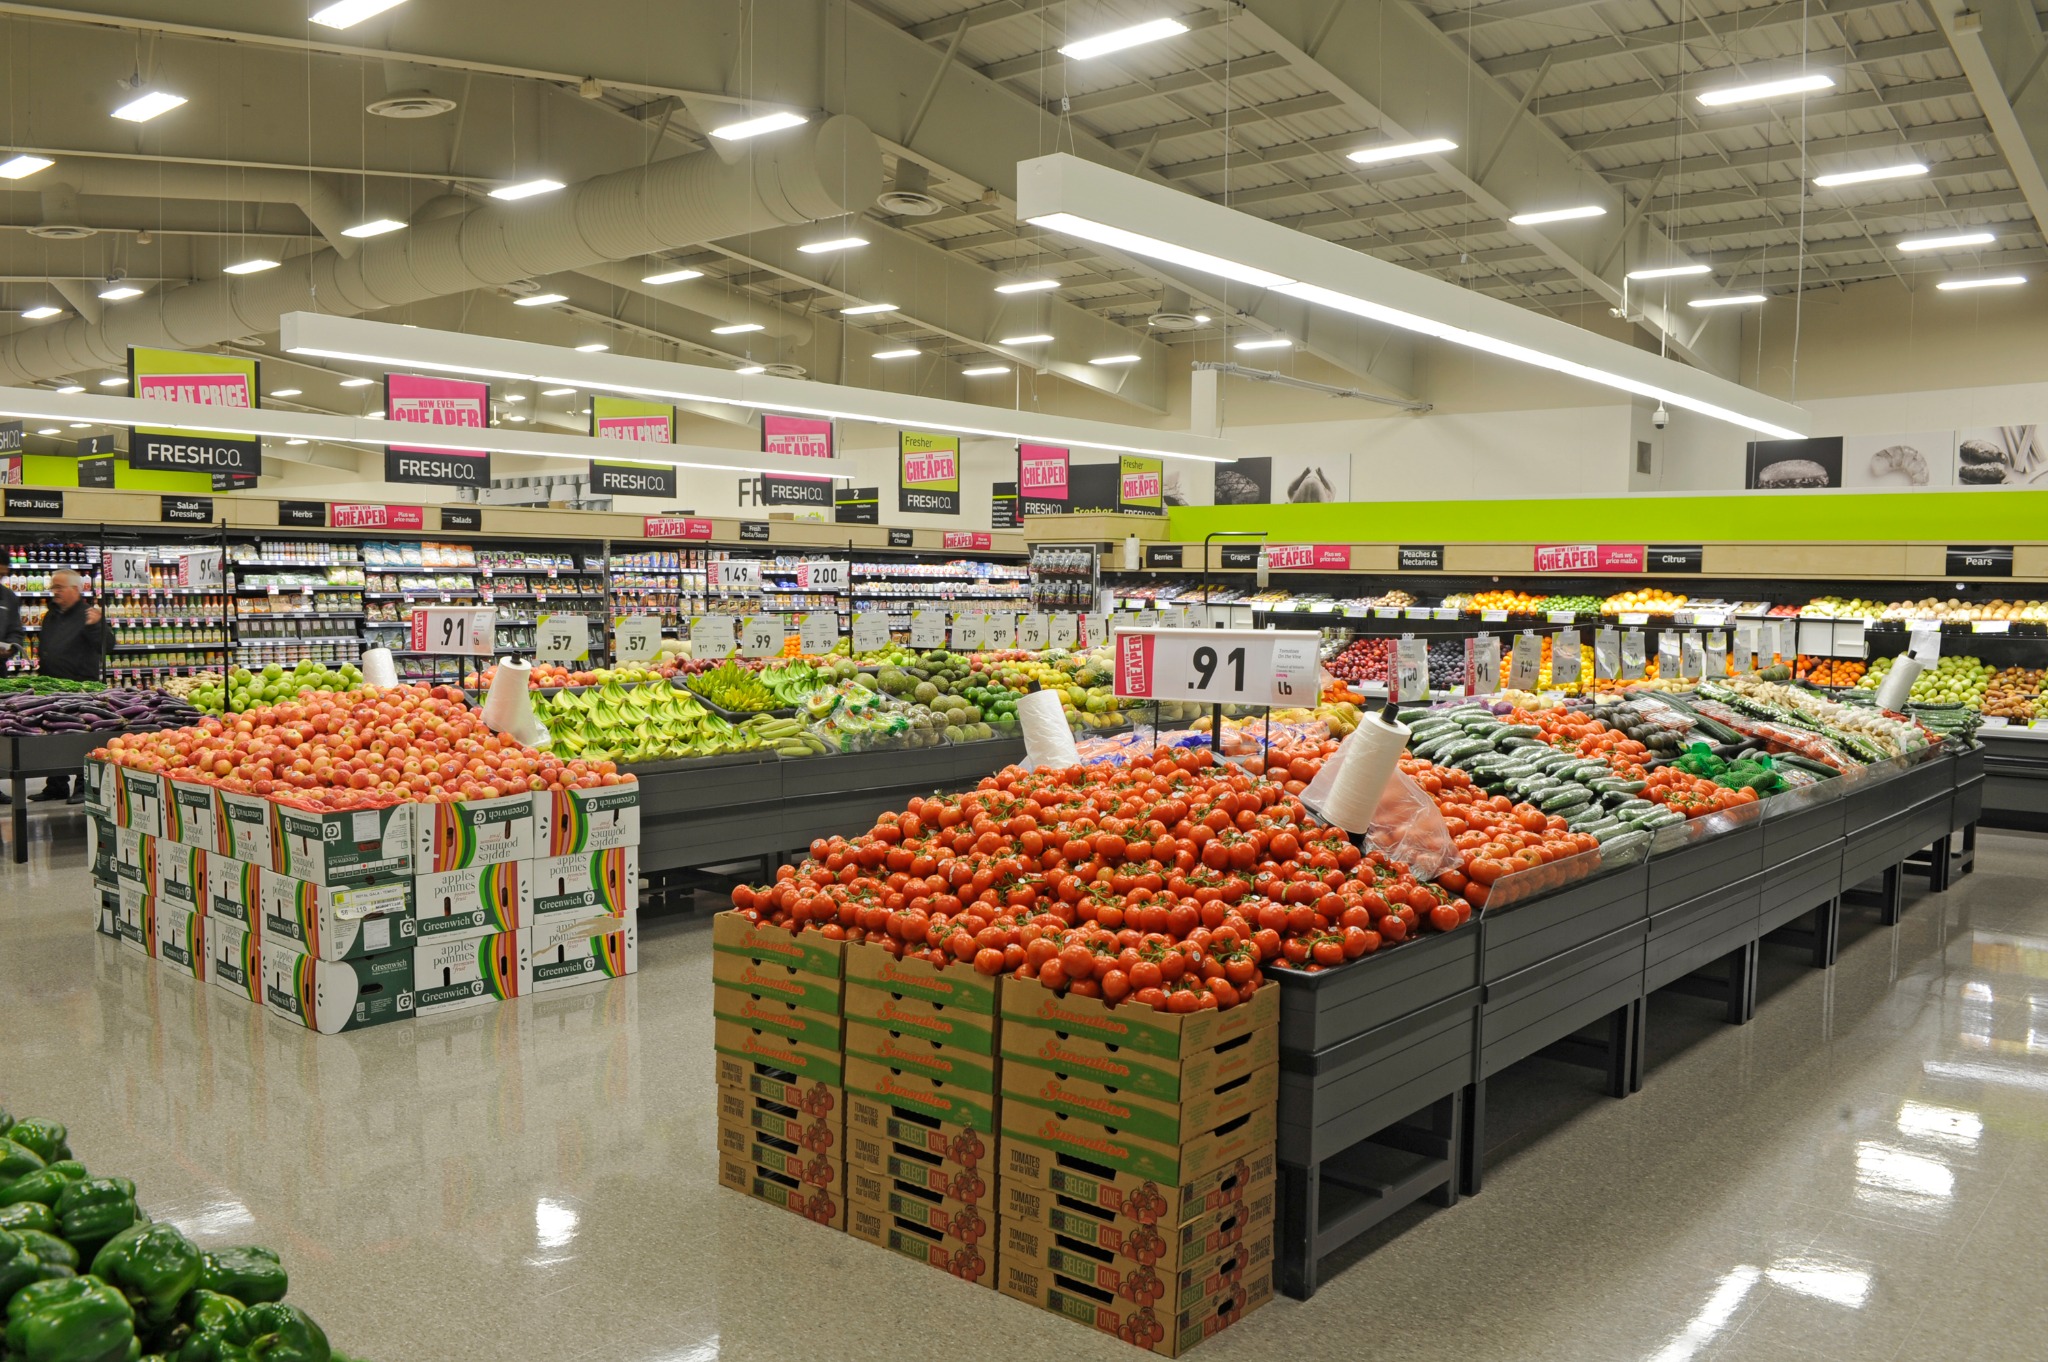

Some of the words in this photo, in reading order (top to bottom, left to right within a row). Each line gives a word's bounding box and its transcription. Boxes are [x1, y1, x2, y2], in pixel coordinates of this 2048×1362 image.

[198, 384, 246, 407] PRICE
[419, 400, 434, 408] NOW
[437, 400, 454, 408] EVEN
[636, 424, 669, 443] PRICE
[92, 438, 98, 454] 2
[905, 436, 932, 448] Fresher
[147, 443, 242, 467] FRESHCO.
[400, 458, 476, 480] FRESHCO.
[906, 458, 954, 482] CHEAPER
[1123, 460, 1144, 470] Fresher
[603, 472, 666, 491] FRESHCO.
[1024, 466, 1065, 486] CHEAPER
[854, 490, 859, 500] 2
[1124, 479, 1159, 498] CHEAPER
[9, 500, 32, 508] Fresh
[34, 500, 59, 509] Juices
[170, 510, 206, 519] Dressings
[292, 510, 312, 518] Herbs
[336, 510, 386, 526] CHEAPER
[452, 516, 472, 524] Salads
[648, 522, 685, 537] CHEAPER
[947, 536, 972, 548] CHEAPER
[1230, 554, 1250, 562] Grapes
[1268, 550, 1313, 568] CHEAPER
[1539, 550, 1596, 570] CHEAPER
[1662, 555, 1686, 563] Citrus
[1966, 557, 1992, 566] Pears
[725, 567, 748, 582] 1.49
[814, 568, 838, 583] 2.00
[441, 618, 464, 646] .91
[1024, 630, 1038, 642] .79
[547, 635, 572, 650] .57
[625, 636, 646, 651] .57
[752, 635, 771, 648] .99
[1129, 635, 1145, 693] CHEAPER
[1188, 646, 1246, 691] .91
[1278, 681, 1292, 695] lb
[600, 795, 636, 808] Greenwich
[489, 805, 529, 820] Greenwich
[591, 825, 626, 838] pommes
[480, 837, 518, 852] pommes
[591, 838, 618, 850] apples
[479, 850, 510, 862] apples
[557, 854, 586, 866] apples
[442, 871, 475, 885] apples
[550, 864, 586, 879] pommes
[434, 882, 475, 898] pommes
[540, 896, 581, 910] Greenwich
[423, 916, 470, 932] Greenwich
[441, 940, 474, 956] apples
[372, 959, 407, 972] Greenwich
[433, 951, 475, 969] pommes
[539, 964, 581, 978] Greenwich
[878, 963, 953, 993] Sunsation
[422, 986, 469, 1002] Greenwich
[877, 1001, 952, 1033] Sunsation
[1037, 1000, 1128, 1034] Sunsation
[877, 1040, 952, 1072] Sunsation
[1039, 1040, 1130, 1076] Sunsation
[761, 1080, 781, 1097] SELECT
[876, 1076, 952, 1109] Sunsation
[787, 1089, 800, 1105] ONE
[1040, 1081, 1131, 1118] Sunsation
[855, 1102, 878, 1120] TOMATOES
[762, 1114, 781, 1132] SELECT
[788, 1124, 800, 1140] ONE
[900, 1124, 923, 1144] SELECT
[1039, 1120, 1129, 1159] Sunsation
[856, 1139, 879, 1156] TOMATES
[931, 1135, 945, 1151] ONE
[762, 1148, 781, 1167] SELECT
[1011, 1150, 1040, 1168] TOMATES
[789, 1159, 801, 1175] ONE
[900, 1161, 923, 1182] SELECT
[1010, 1162, 1018, 1171] sur
[1024, 1166, 1039, 1178] VIGNE
[856, 1175, 880, 1192] TOMATES
[932, 1173, 946, 1190] ONE
[1065, 1175, 1094, 1198] SELECT
[764, 1183, 783, 1202] SELECT
[1011, 1189, 1040, 1208] TOMATES
[1102, 1189, 1120, 1206] ONE
[790, 1194, 802, 1210] ONE
[901, 1199, 924, 1220] SELECT
[1010, 1202, 1018, 1210] sur
[1024, 1205, 1039, 1218] VIGNE
[856, 1211, 880, 1229] TOMATES
[932, 1212, 946, 1228] ONE
[1065, 1216, 1094, 1238] SELECT
[1010, 1228, 1038, 1246] TOMATOES
[1102, 1229, 1119, 1246] ONE
[901, 1236, 924, 1257] SELECT
[1009, 1241, 1016, 1249] on
[1016, 1241, 1025, 1251] the
[1026, 1244, 1037, 1257] VINE
[932, 1250, 946, 1266] ONE
[1063, 1255, 1091, 1278] SELECT
[1010, 1268, 1038, 1288] TOMATES
[1101, 1270, 1117, 1287] ONE
[1009, 1280, 1017, 1288] sur
[1023, 1284, 1037, 1298] VIGNE
[1063, 1298, 1091, 1320] SELECT
[1100, 1312, 1116, 1329] ONE
